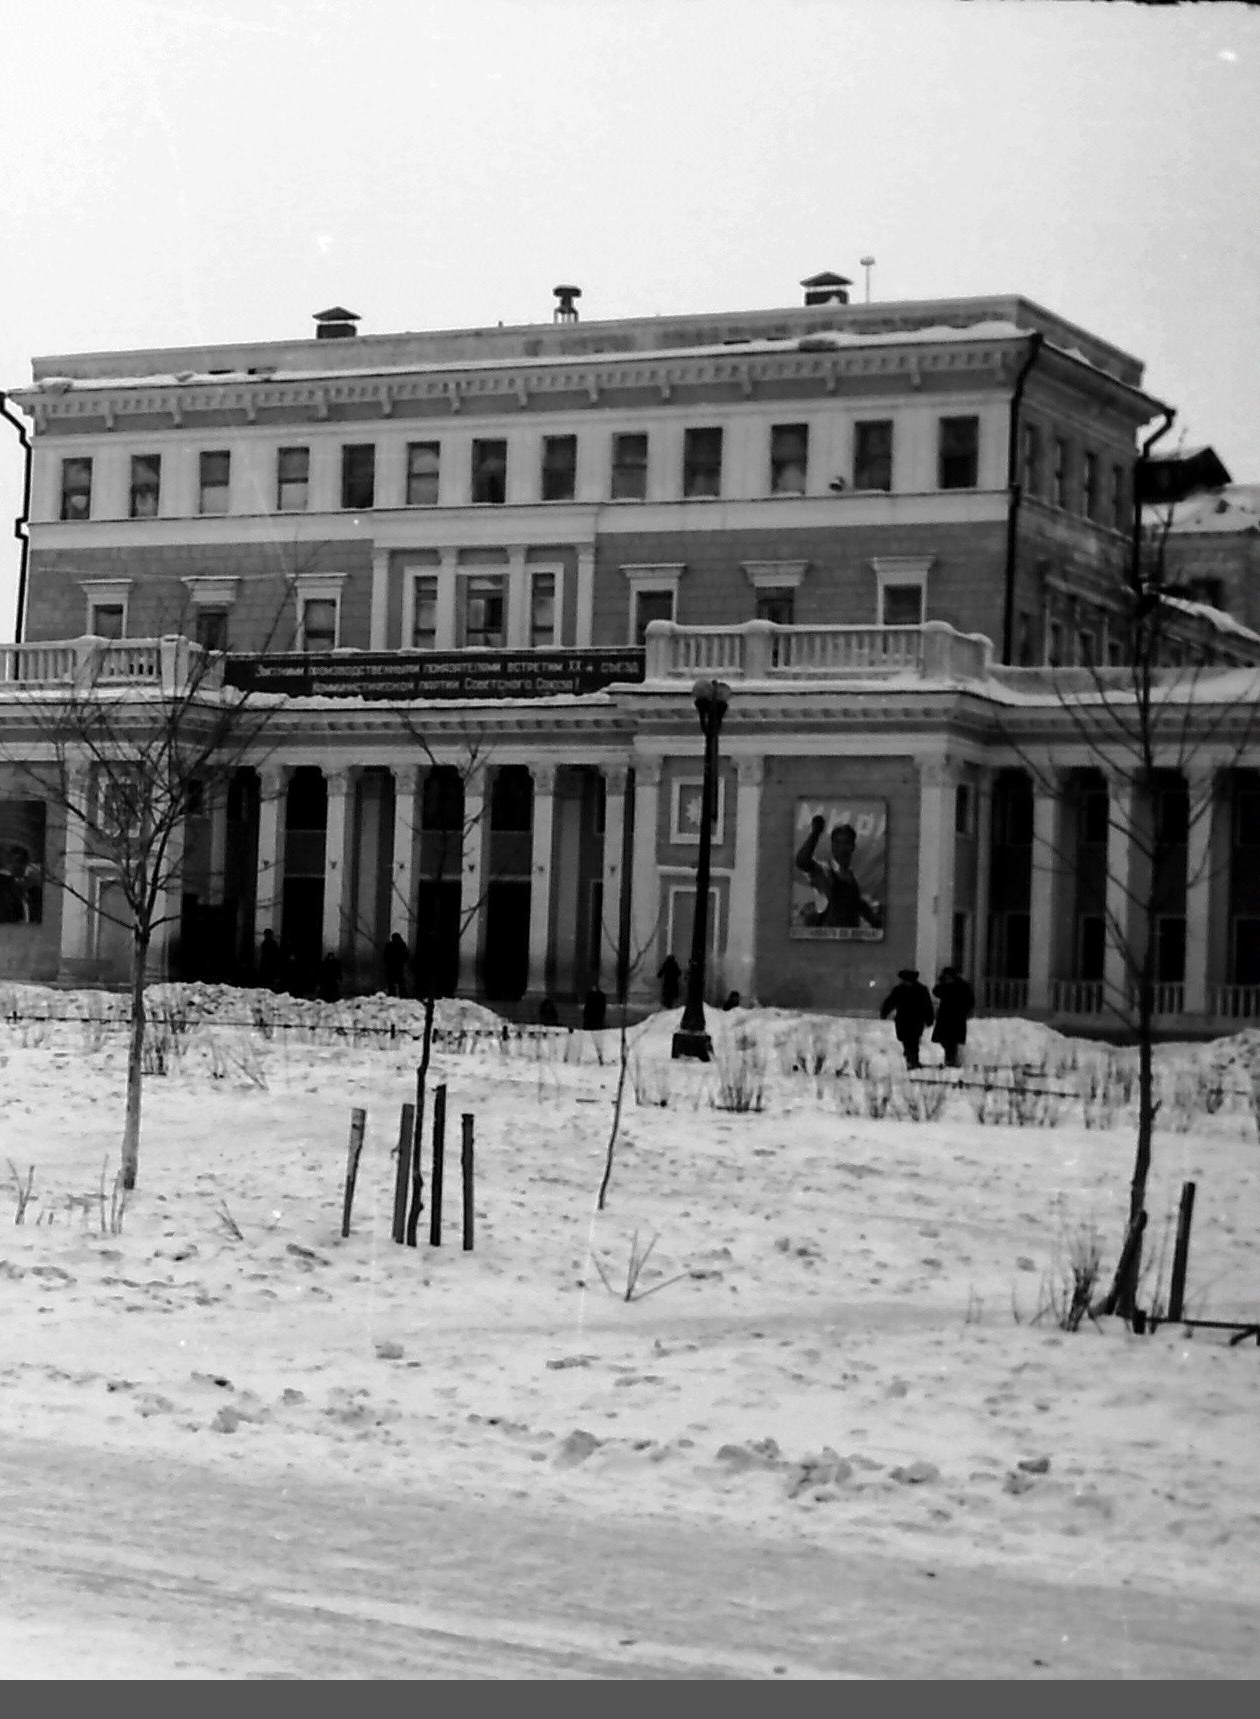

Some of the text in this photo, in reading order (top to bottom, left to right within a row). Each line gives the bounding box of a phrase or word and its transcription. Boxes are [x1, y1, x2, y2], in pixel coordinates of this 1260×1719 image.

[423, 662, 501, 674] показателями
[507, 661, 563, 673] встретим
[601, 661, 638, 673] съезд
[418, 679, 460, 691] партии
[464, 677, 532, 690] Советского
